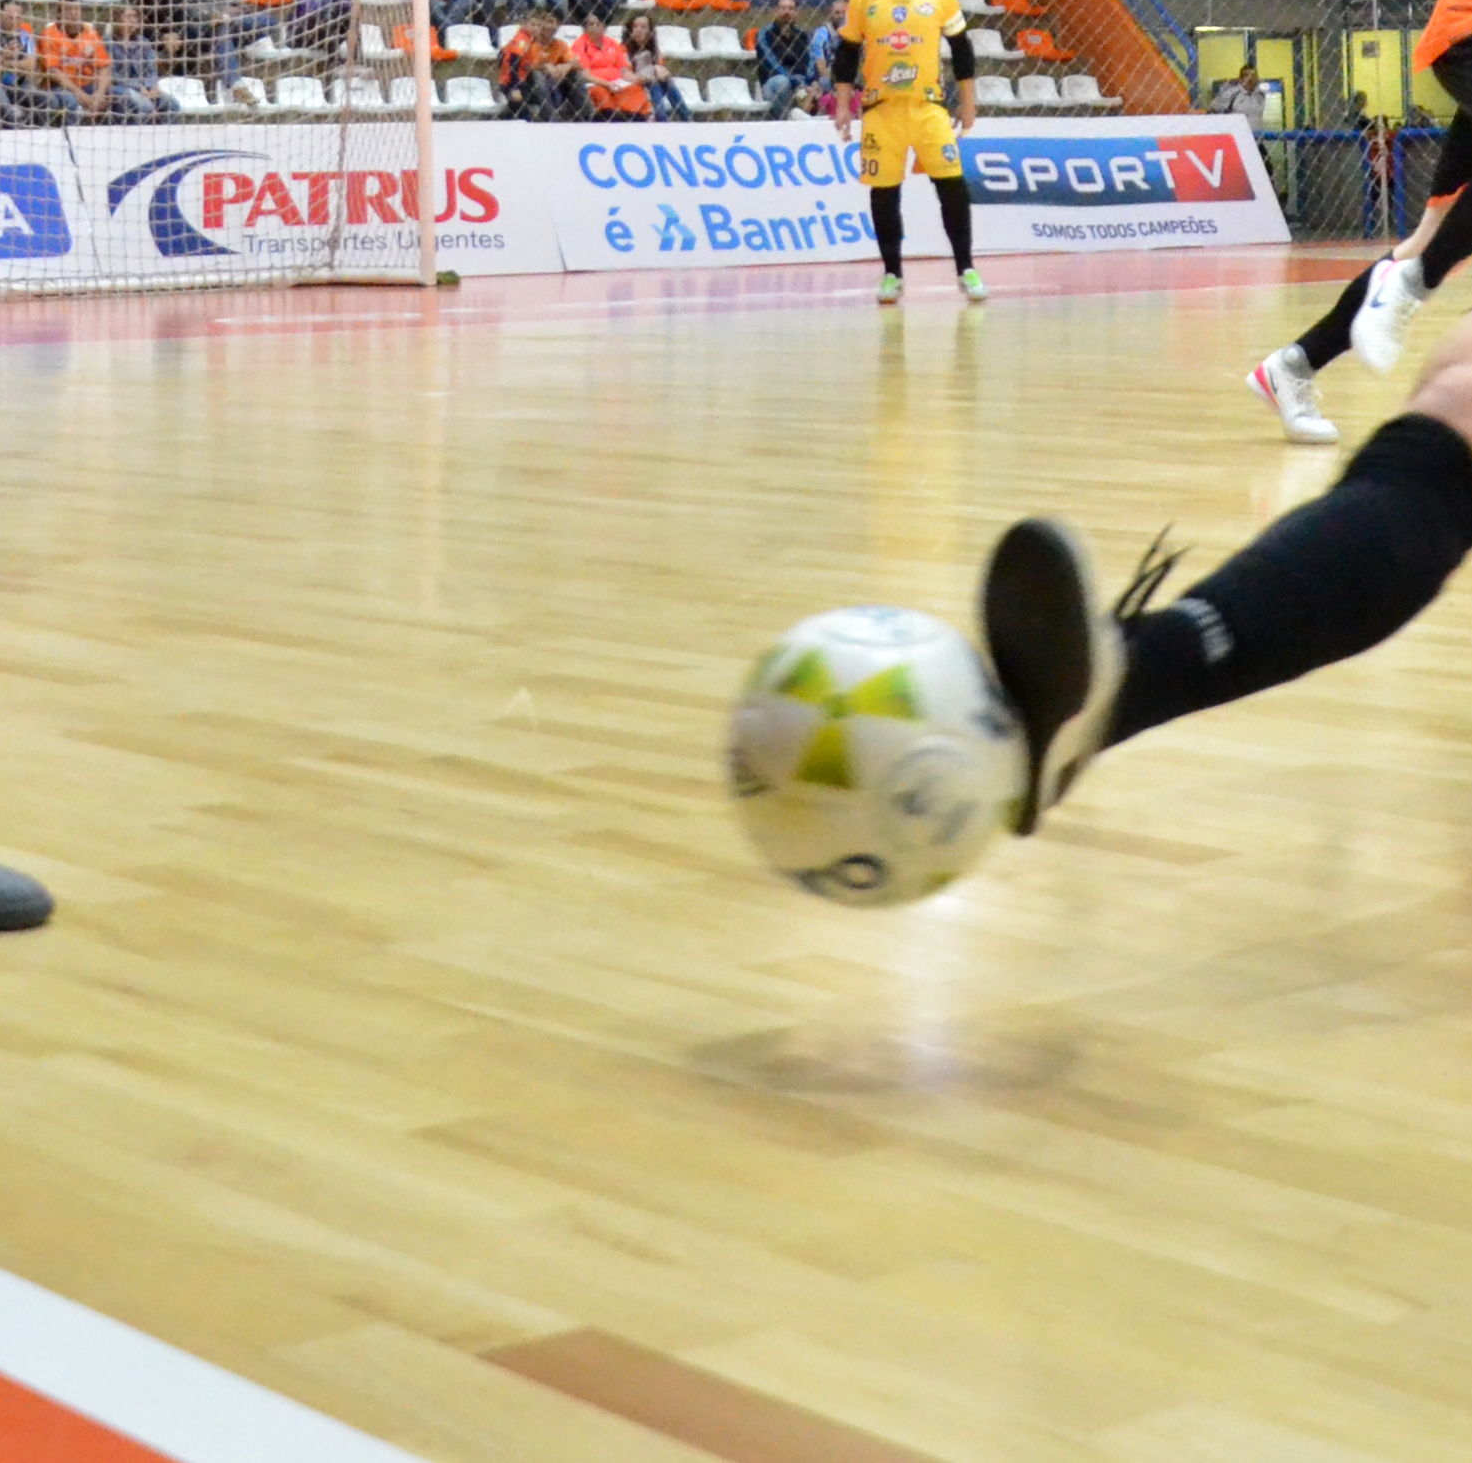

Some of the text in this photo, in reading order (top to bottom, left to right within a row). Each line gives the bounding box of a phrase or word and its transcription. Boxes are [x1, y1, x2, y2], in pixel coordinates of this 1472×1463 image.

[202, 167, 500, 229] PATRUS
[1032, 216, 1219, 240] SOMOS TODOS CAMPEÕES
